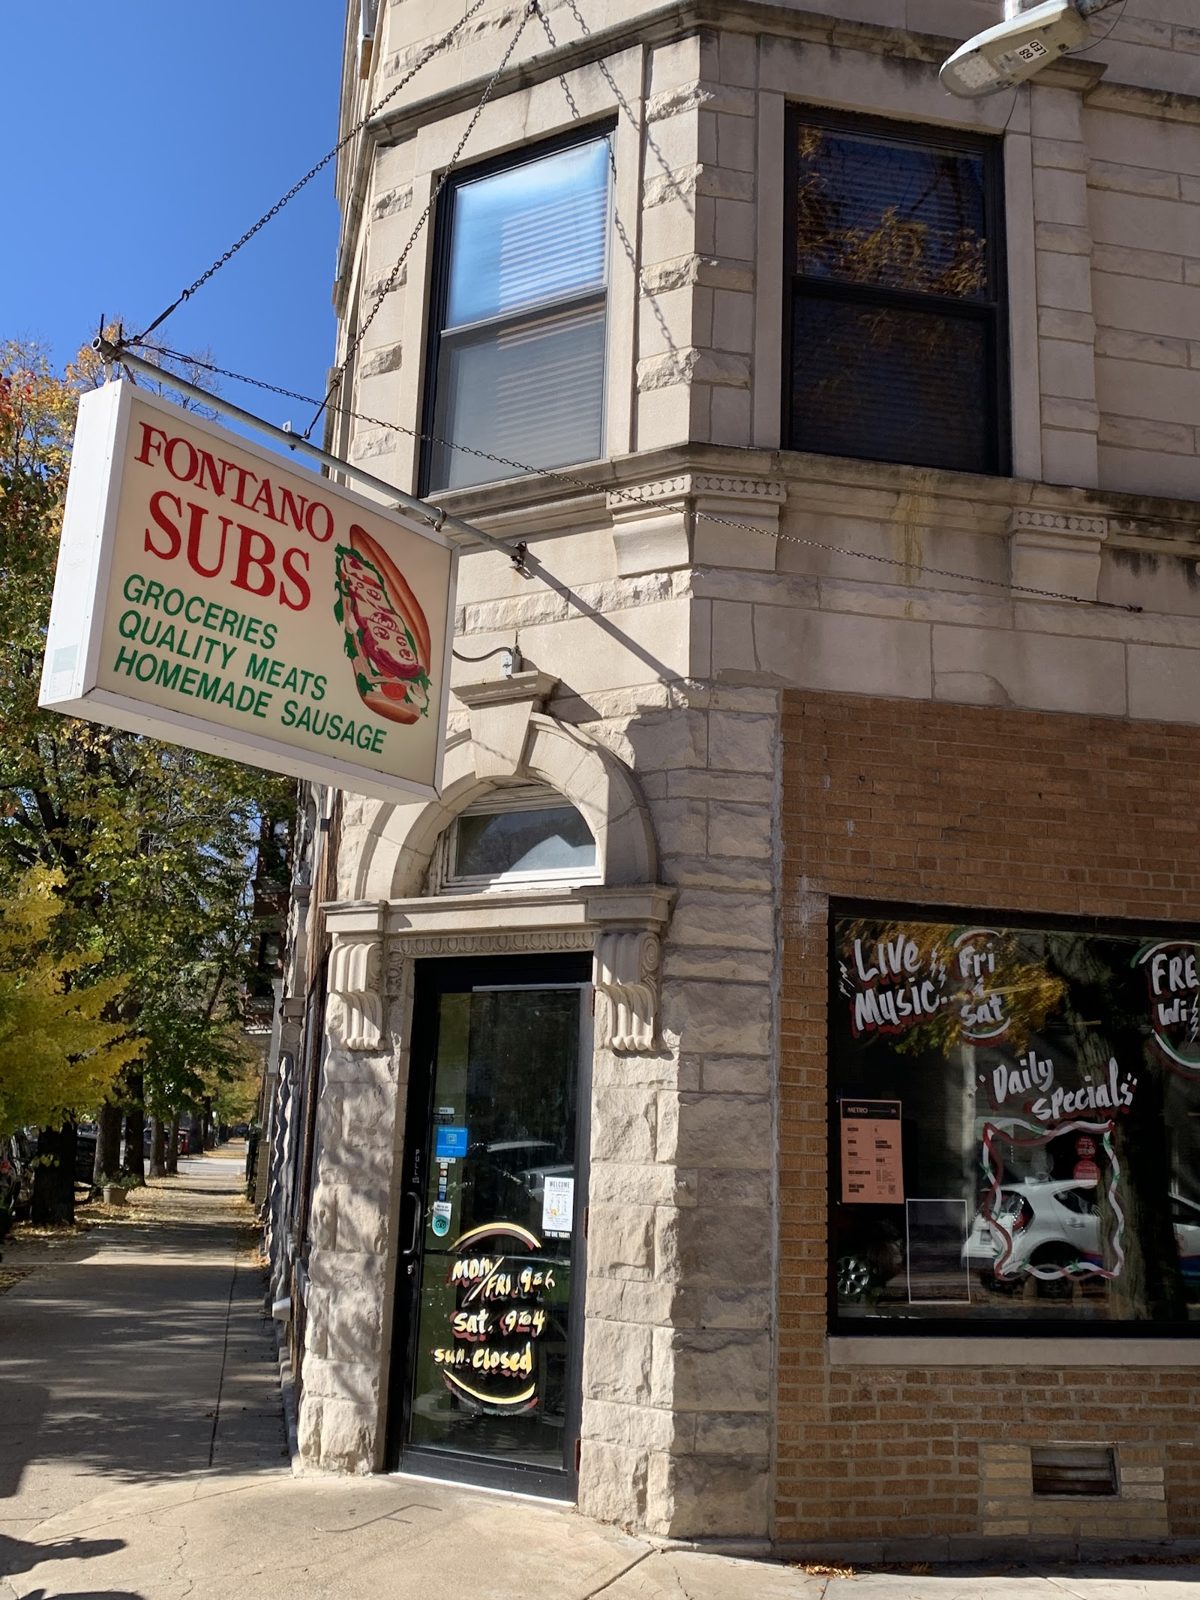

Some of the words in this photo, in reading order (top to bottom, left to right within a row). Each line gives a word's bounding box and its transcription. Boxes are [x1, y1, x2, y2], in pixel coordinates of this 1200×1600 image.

[1018, 48, 1034, 60] 68
[1029, 41, 1048, 56] LED
[134, 421, 335, 542] FONTANO
[144, 490, 311, 611] SUBS
[123, 573, 278, 650] GROCERIES
[118, 609, 237, 670] QUALITY
[245, 653, 327, 701] MEATS
[114, 646, 272, 718] HOMEMADE
[280, 700, 387, 755] SAUSAGE
[847, 1106, 868, 1114] METRO
[549, 1181, 570, 1189] WELCOME
[521, 1266, 533, 1293] 9
[504, 1310, 517, 1333] 9
[532, 1309, 546, 1336] 4
